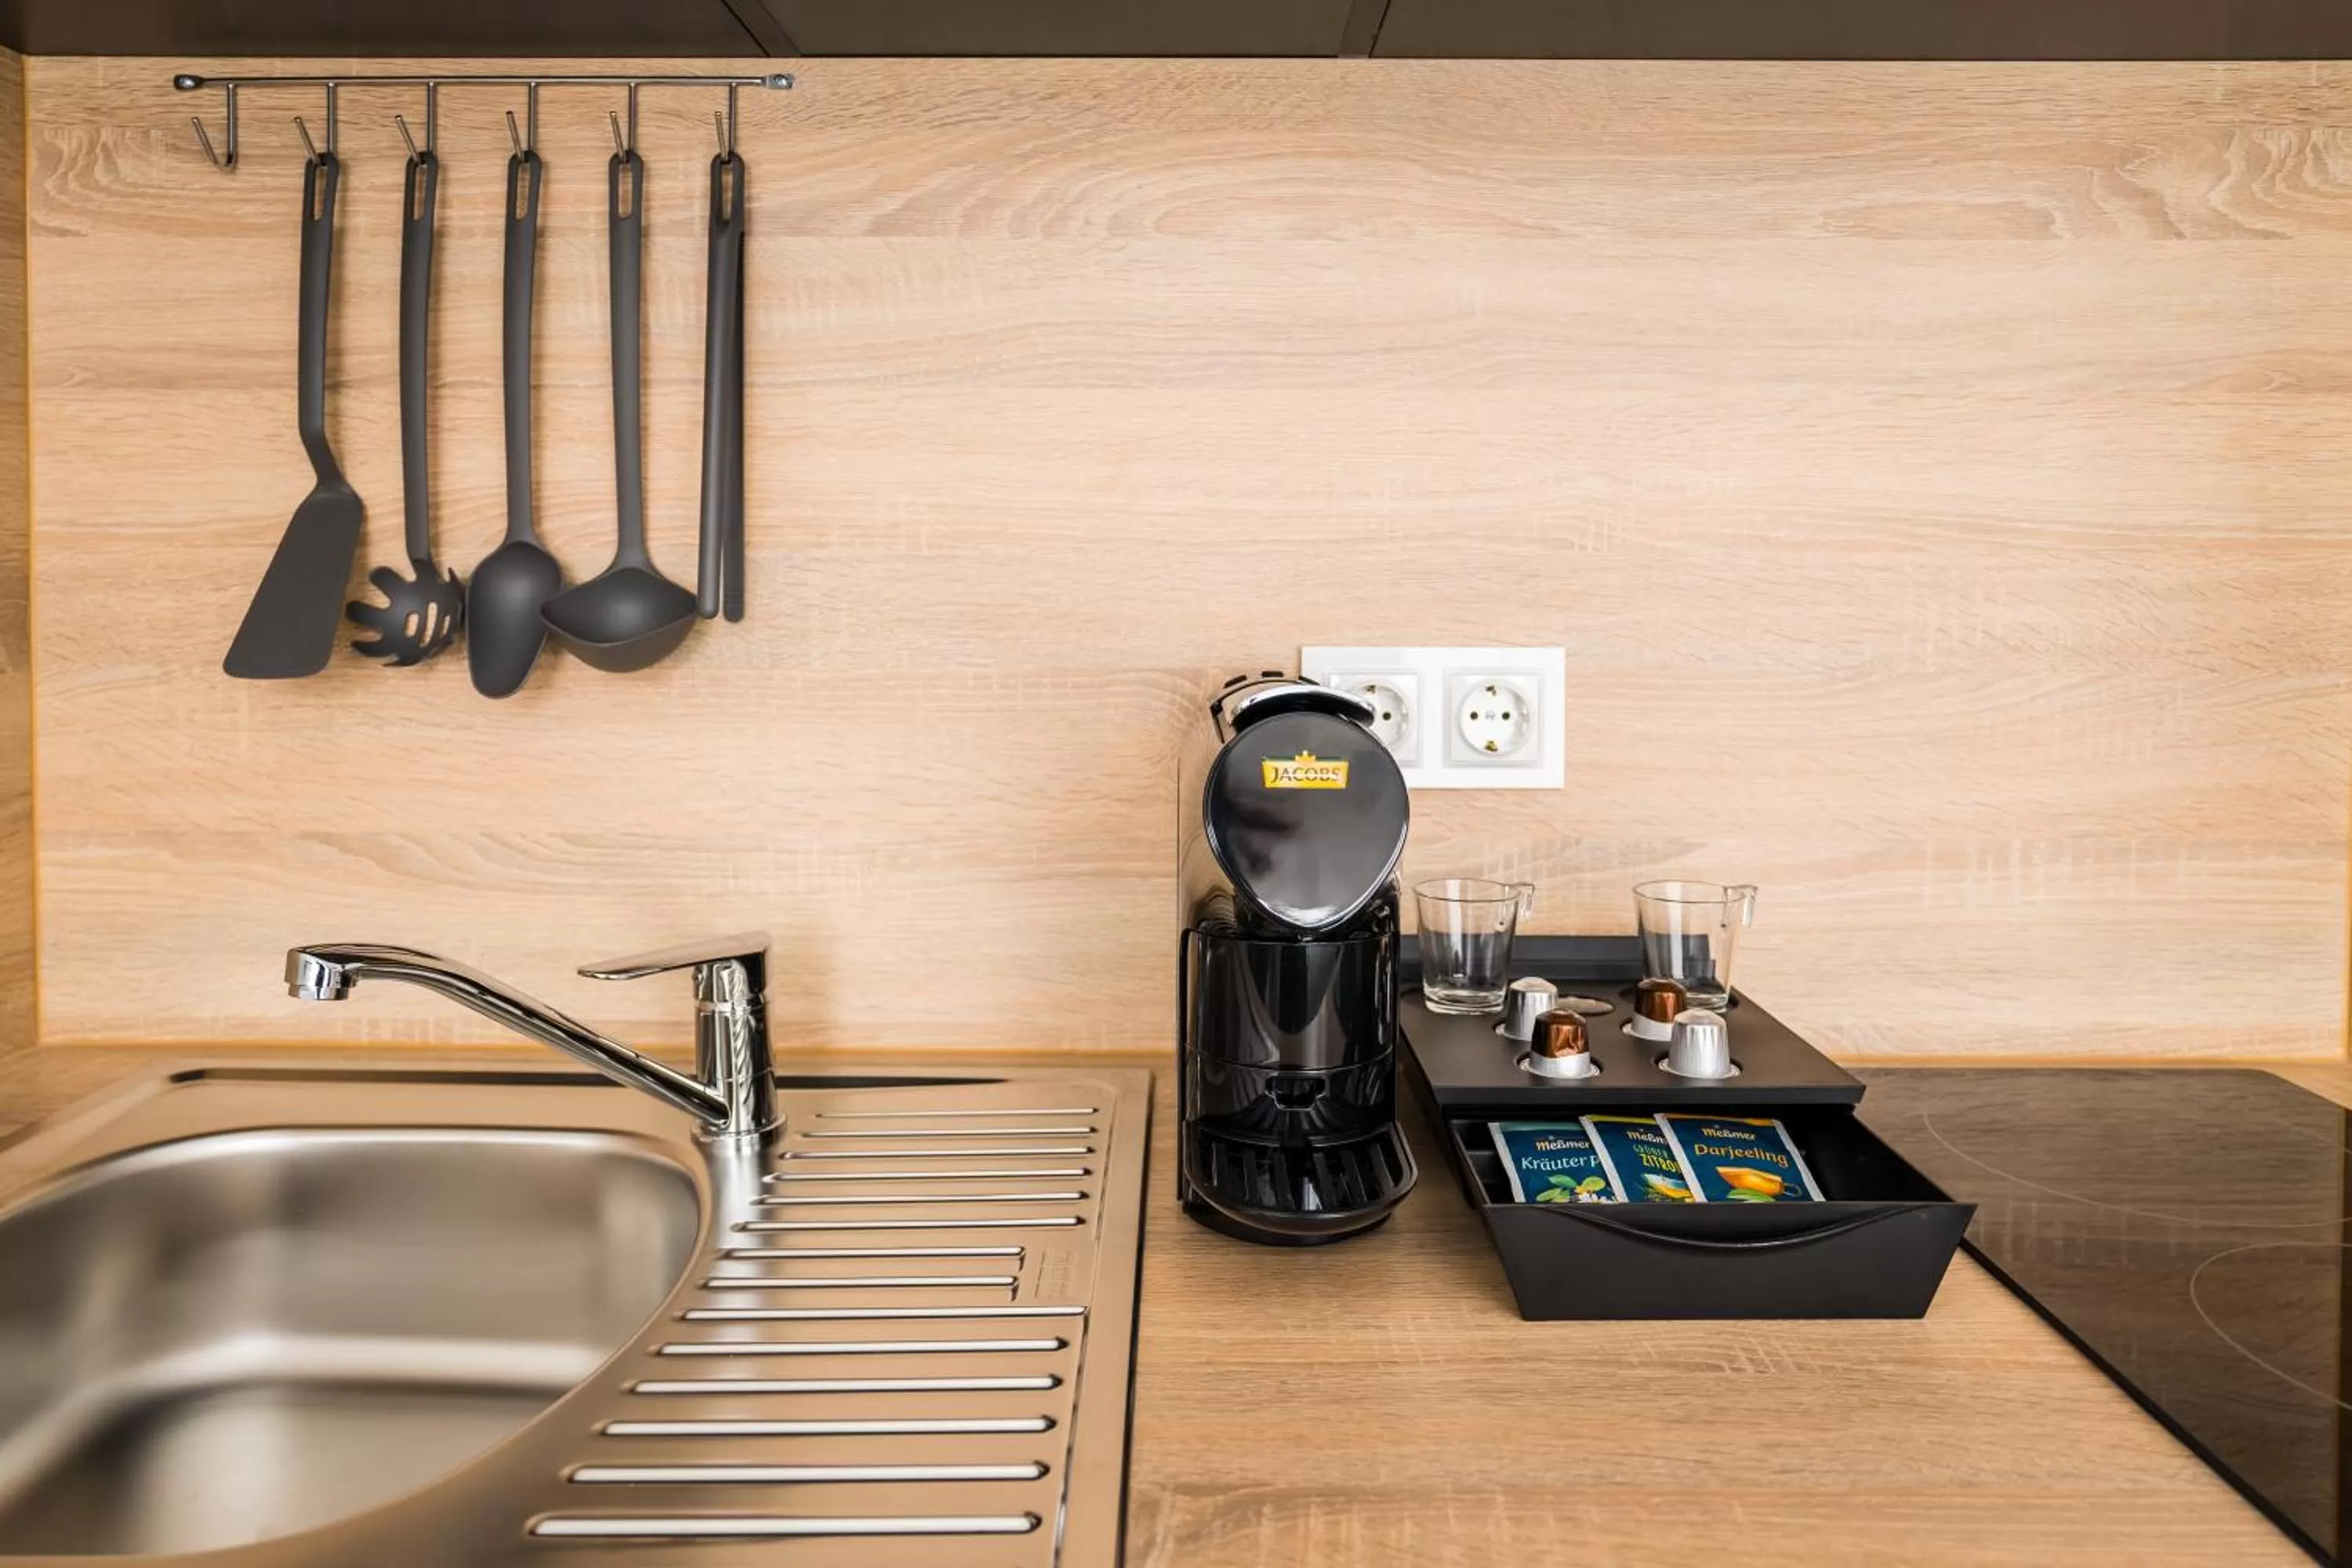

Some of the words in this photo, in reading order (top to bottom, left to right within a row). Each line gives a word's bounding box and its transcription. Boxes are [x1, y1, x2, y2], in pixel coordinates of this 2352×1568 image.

[1270, 767, 1341, 782] JACOBS
[1694, 1144, 1788, 1167] Darjeeling
[1522, 1156, 1587, 1171] Kräuter
